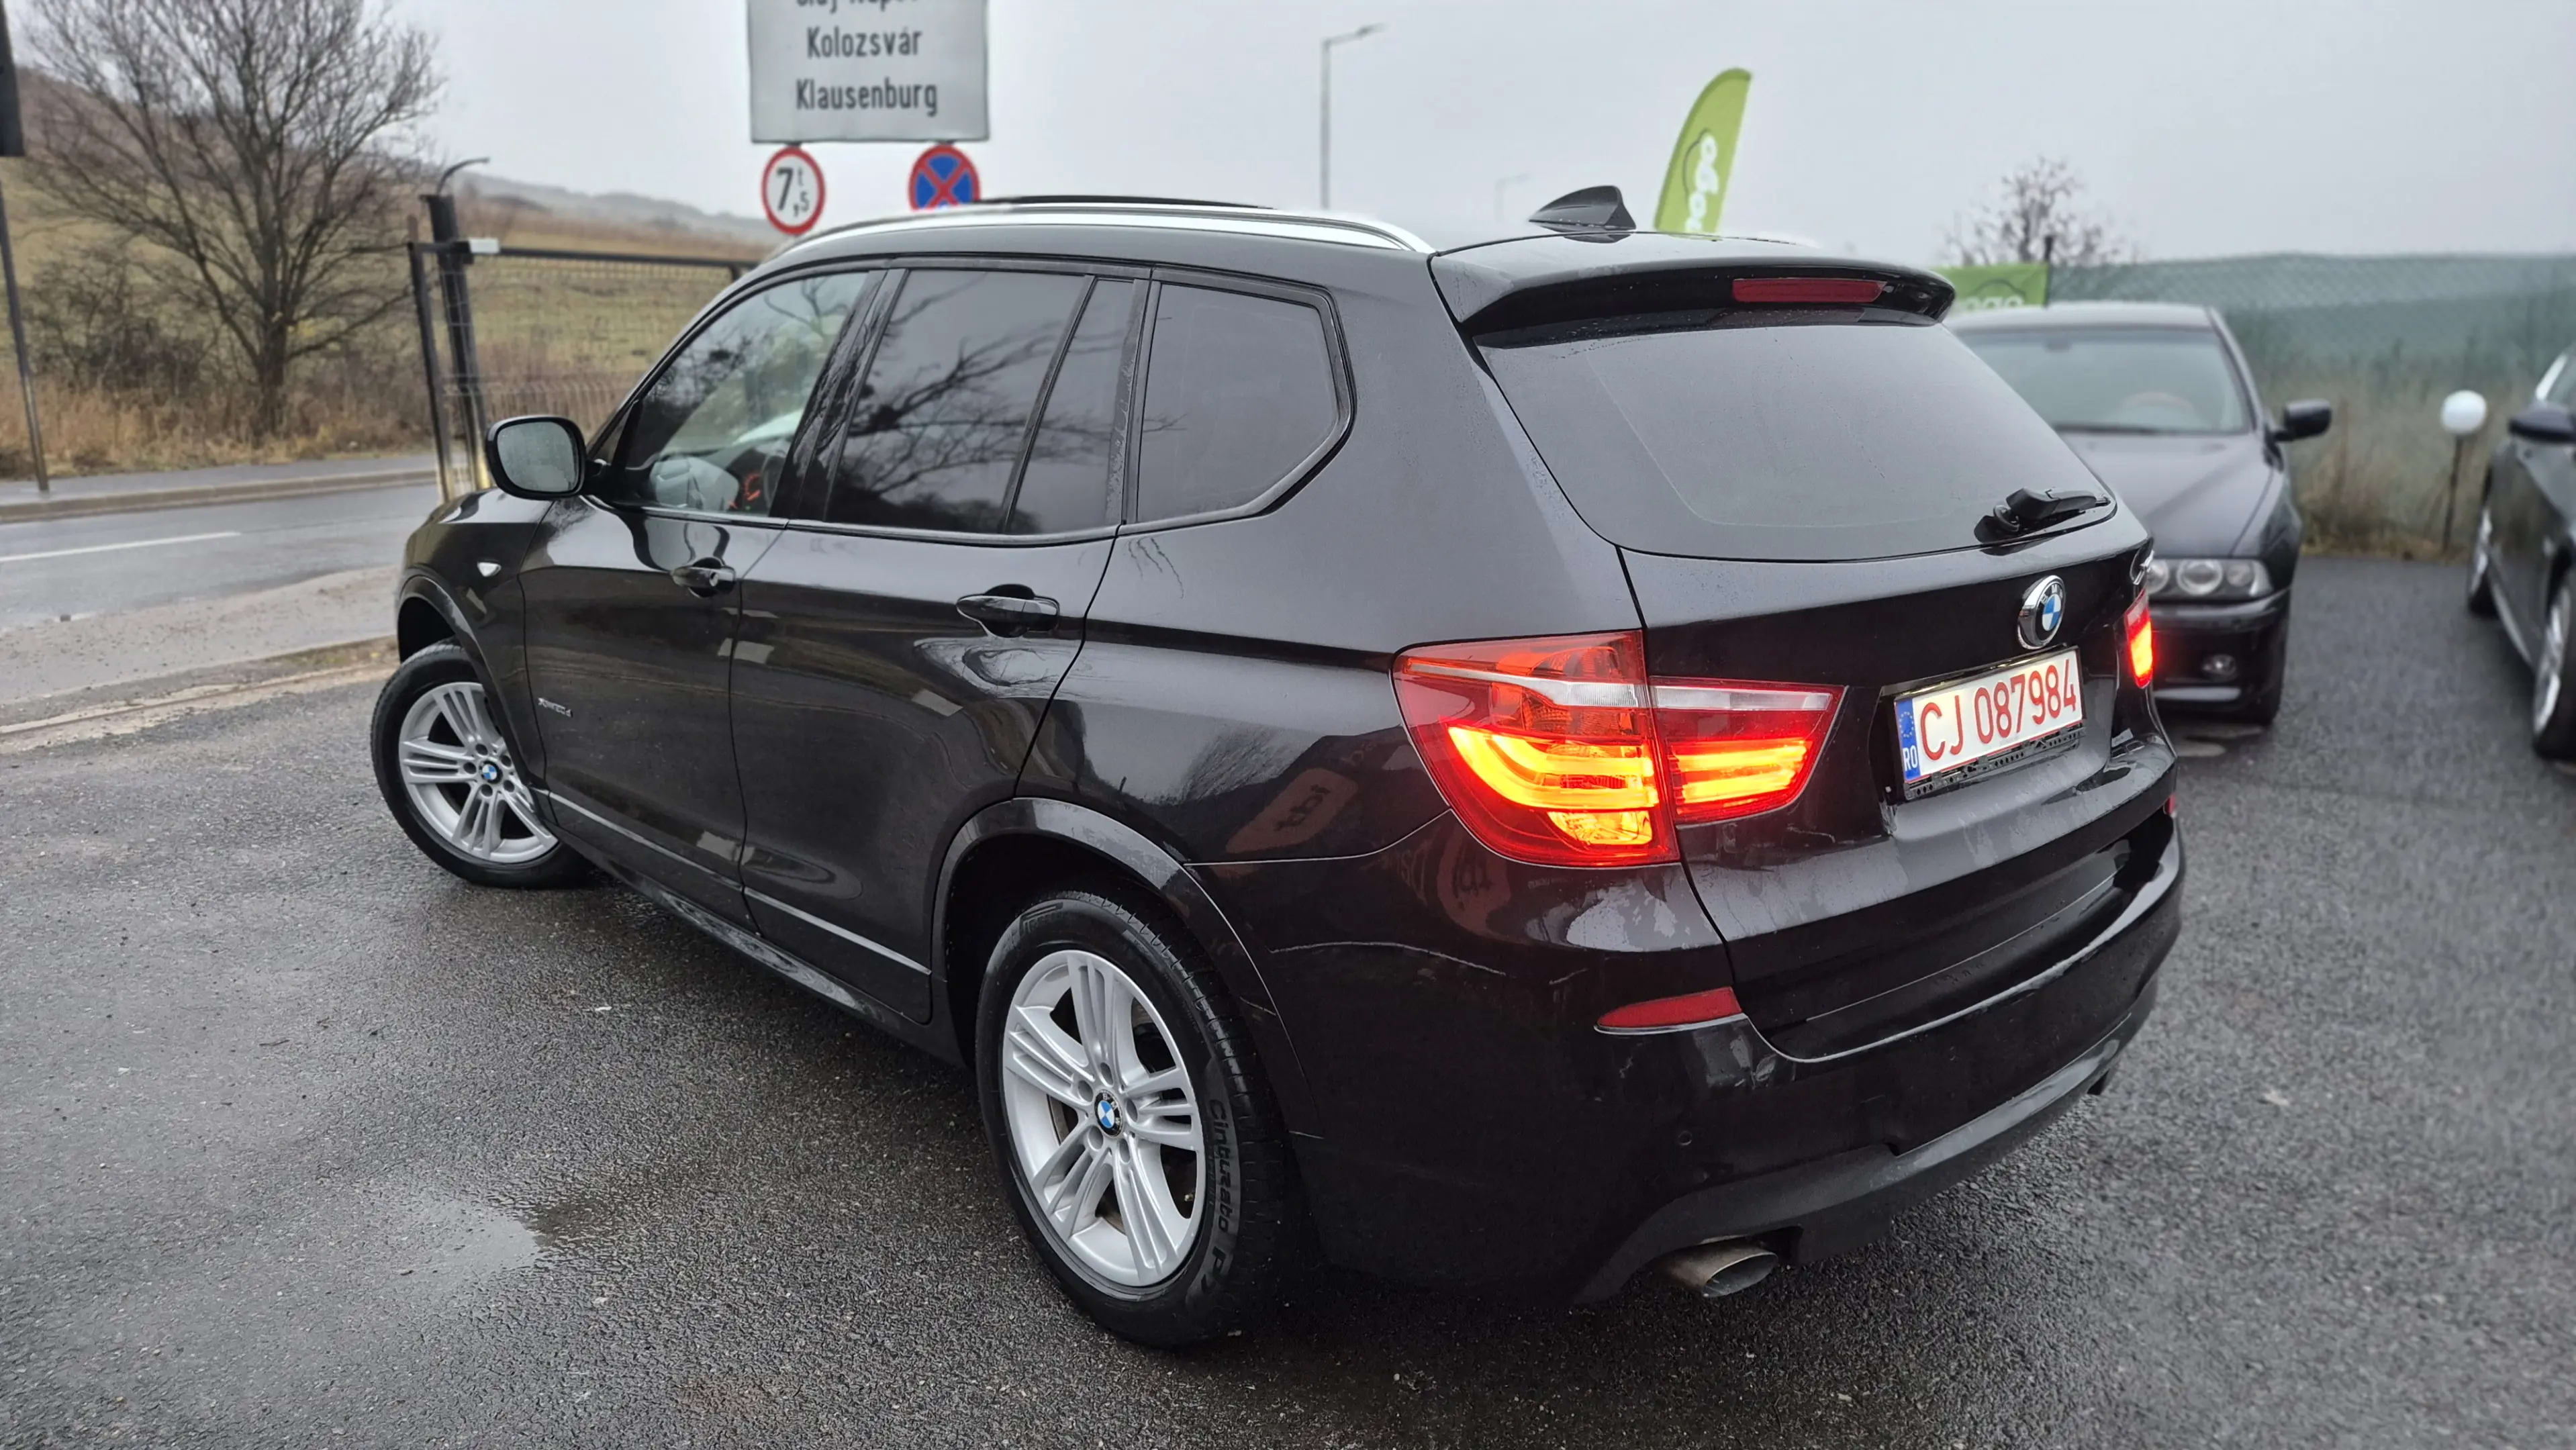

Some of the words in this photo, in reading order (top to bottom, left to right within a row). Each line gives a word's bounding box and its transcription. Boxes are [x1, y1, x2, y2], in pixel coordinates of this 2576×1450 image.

[807, 26, 922, 59] Kolozsvár
[796, 77, 938, 118] Klausenburg
[1920, 695, 1964, 761] CJ
[1974, 659, 2077, 744] 087984
[1903, 745, 1919, 771] RO
